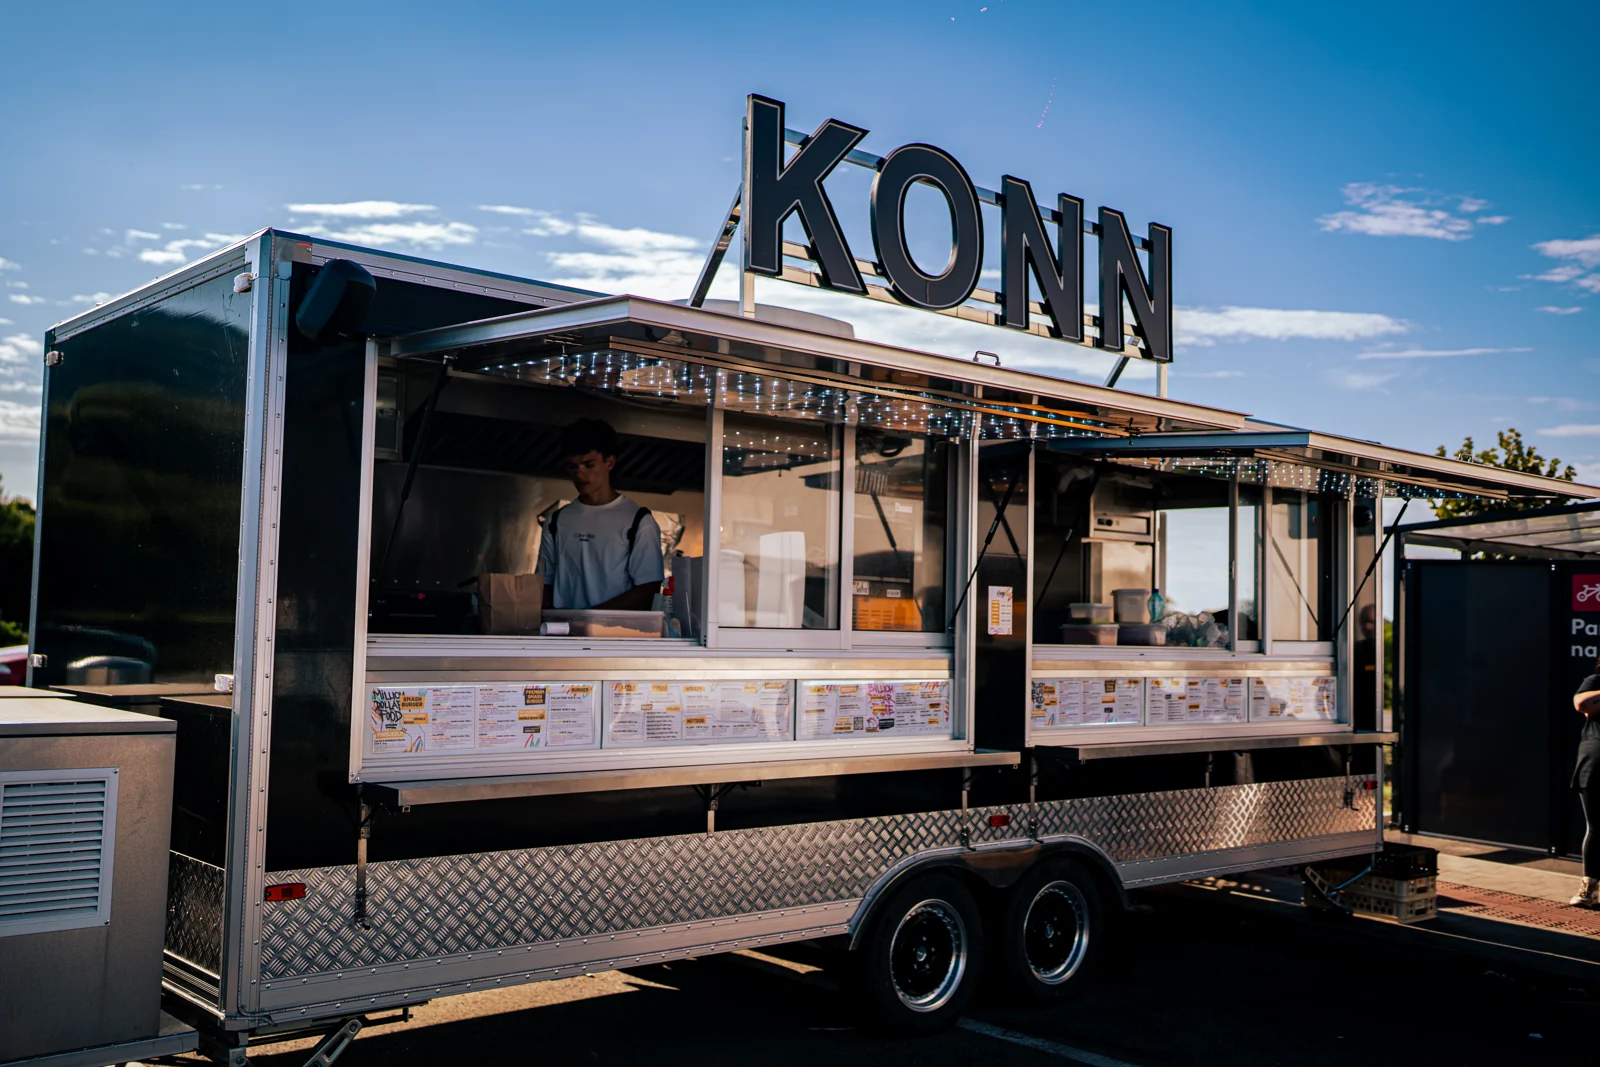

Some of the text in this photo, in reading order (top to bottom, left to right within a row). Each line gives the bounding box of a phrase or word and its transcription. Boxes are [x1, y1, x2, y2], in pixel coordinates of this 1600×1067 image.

[747, 93, 1173, 363] KONN
[1571, 618, 1600, 636] Pa
[1571, 645, 1598, 658] na
[380, 709, 403, 723] FOOD
